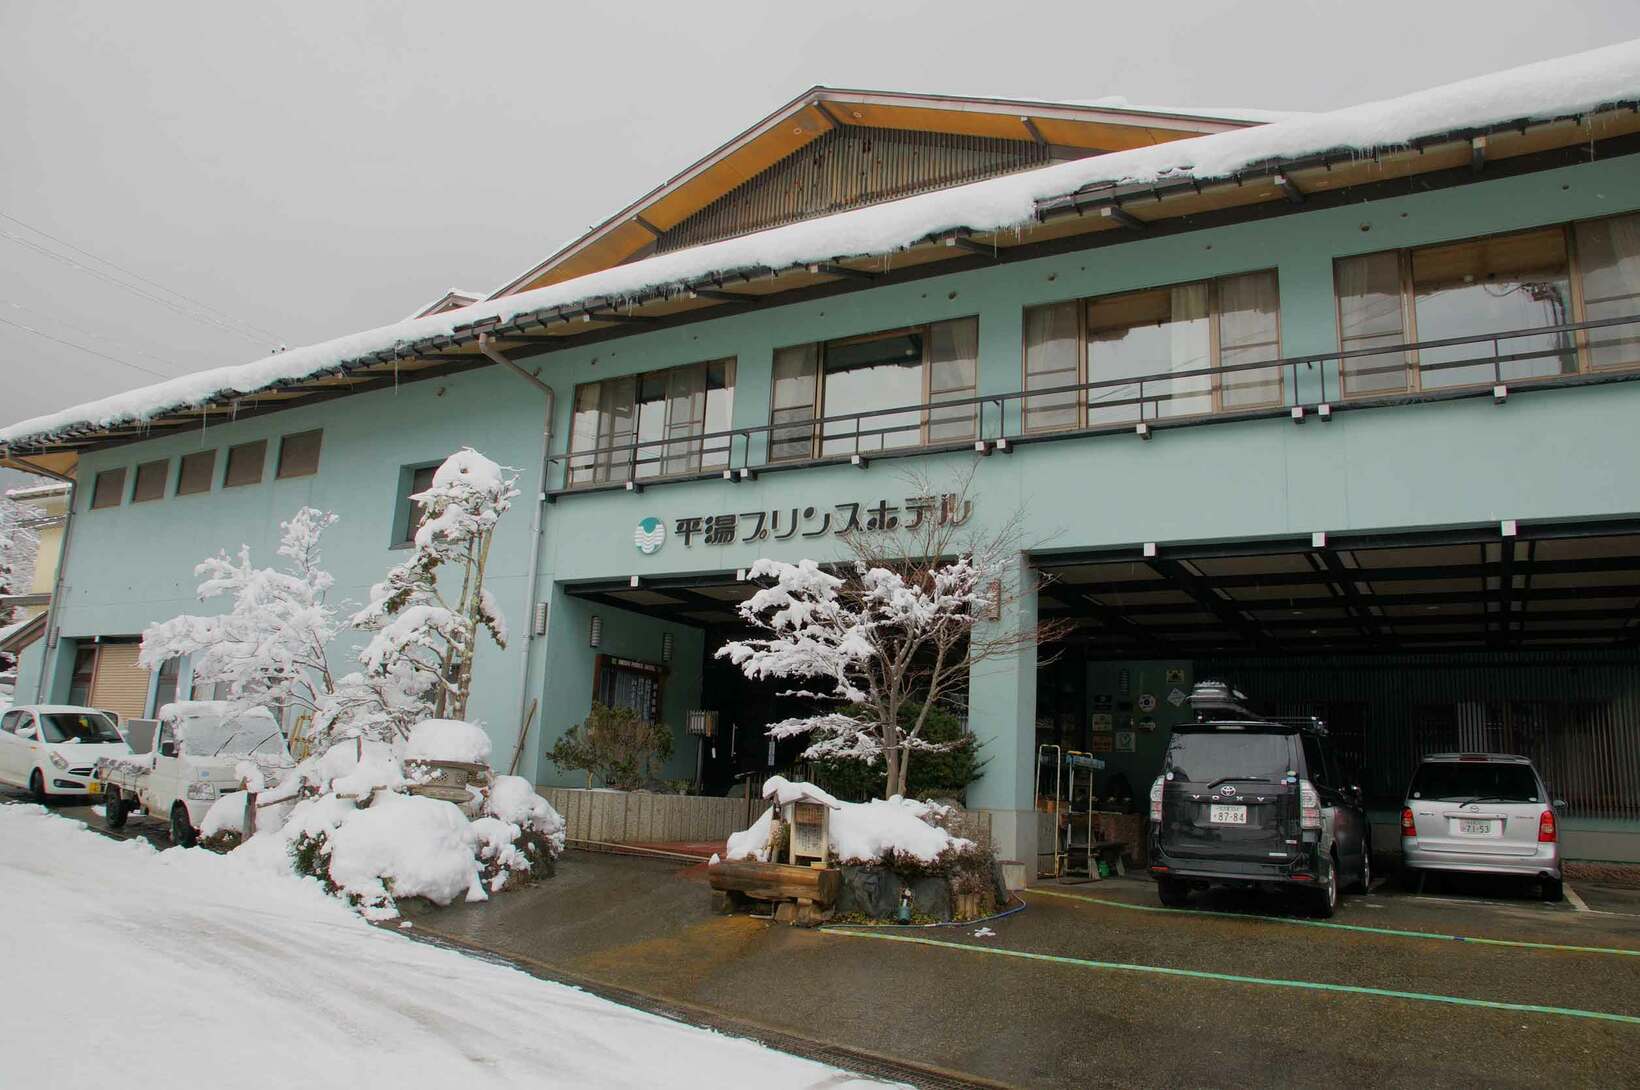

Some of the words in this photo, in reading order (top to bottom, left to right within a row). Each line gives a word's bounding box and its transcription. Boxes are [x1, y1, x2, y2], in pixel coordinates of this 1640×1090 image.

[675, 493, 974, 550] 平湯プリンスホテル
[1192, 794, 1265, 802] VOXY
